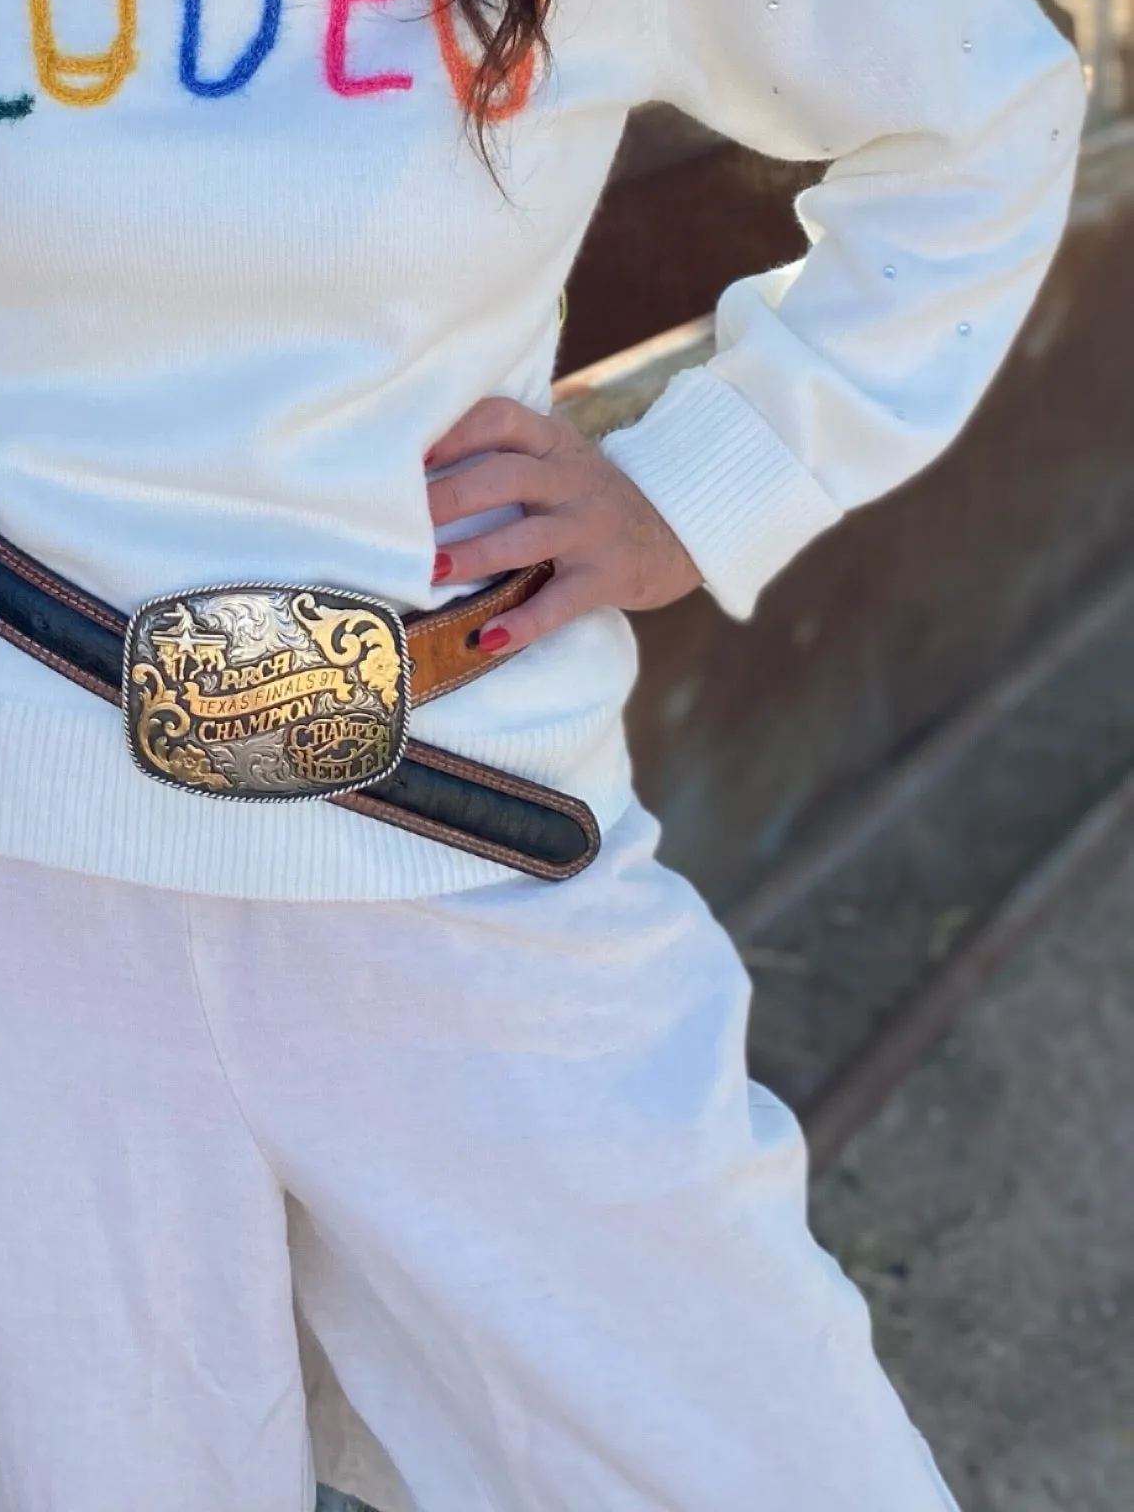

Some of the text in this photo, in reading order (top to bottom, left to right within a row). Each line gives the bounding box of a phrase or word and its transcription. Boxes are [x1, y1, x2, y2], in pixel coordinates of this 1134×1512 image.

[198, 696, 249, 714] TEXAS
[253, 673, 316, 706] FINALS
[198, 694, 316, 744] CHAMPION
[289, 721, 392, 751] CHAMPION
[292, 738, 392, 782] HEELER
